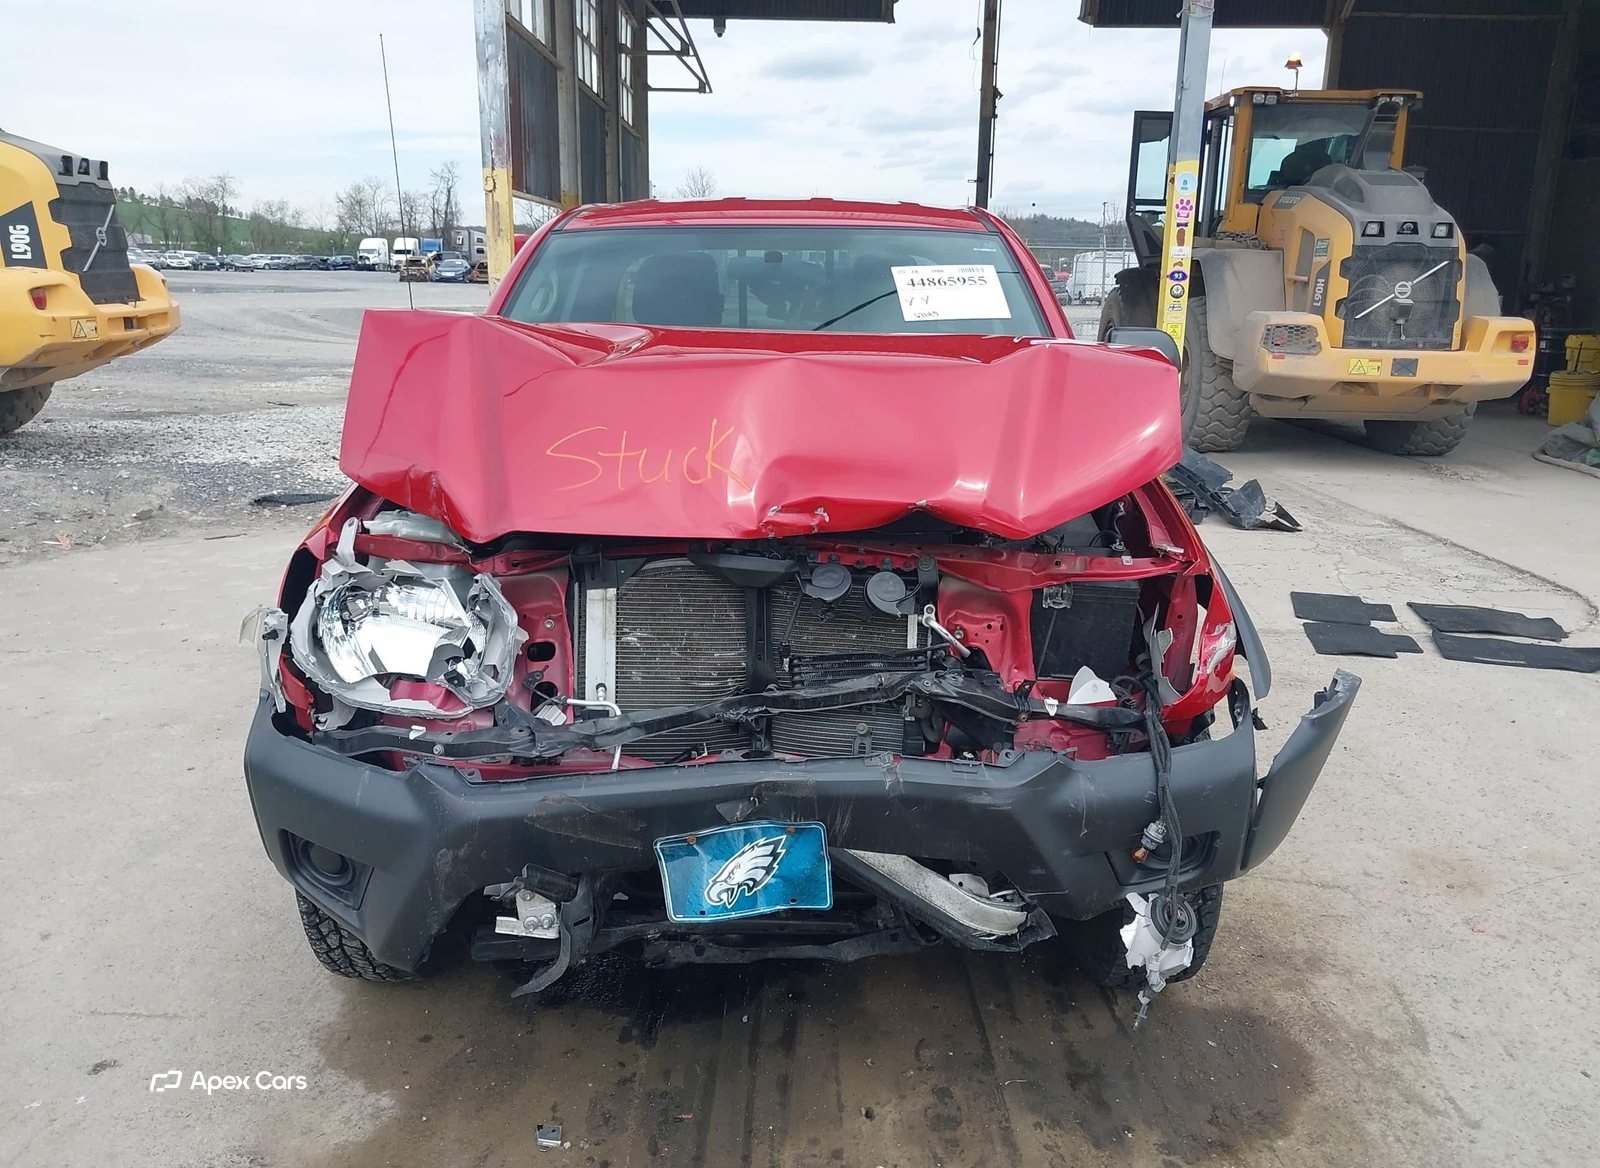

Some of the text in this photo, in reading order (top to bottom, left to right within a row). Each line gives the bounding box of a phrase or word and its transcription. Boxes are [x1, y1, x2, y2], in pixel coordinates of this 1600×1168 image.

[8, 224, 32, 260] L90G
[906, 276, 988, 288] 44865955
[1312, 278, 1326, 307] L90H
